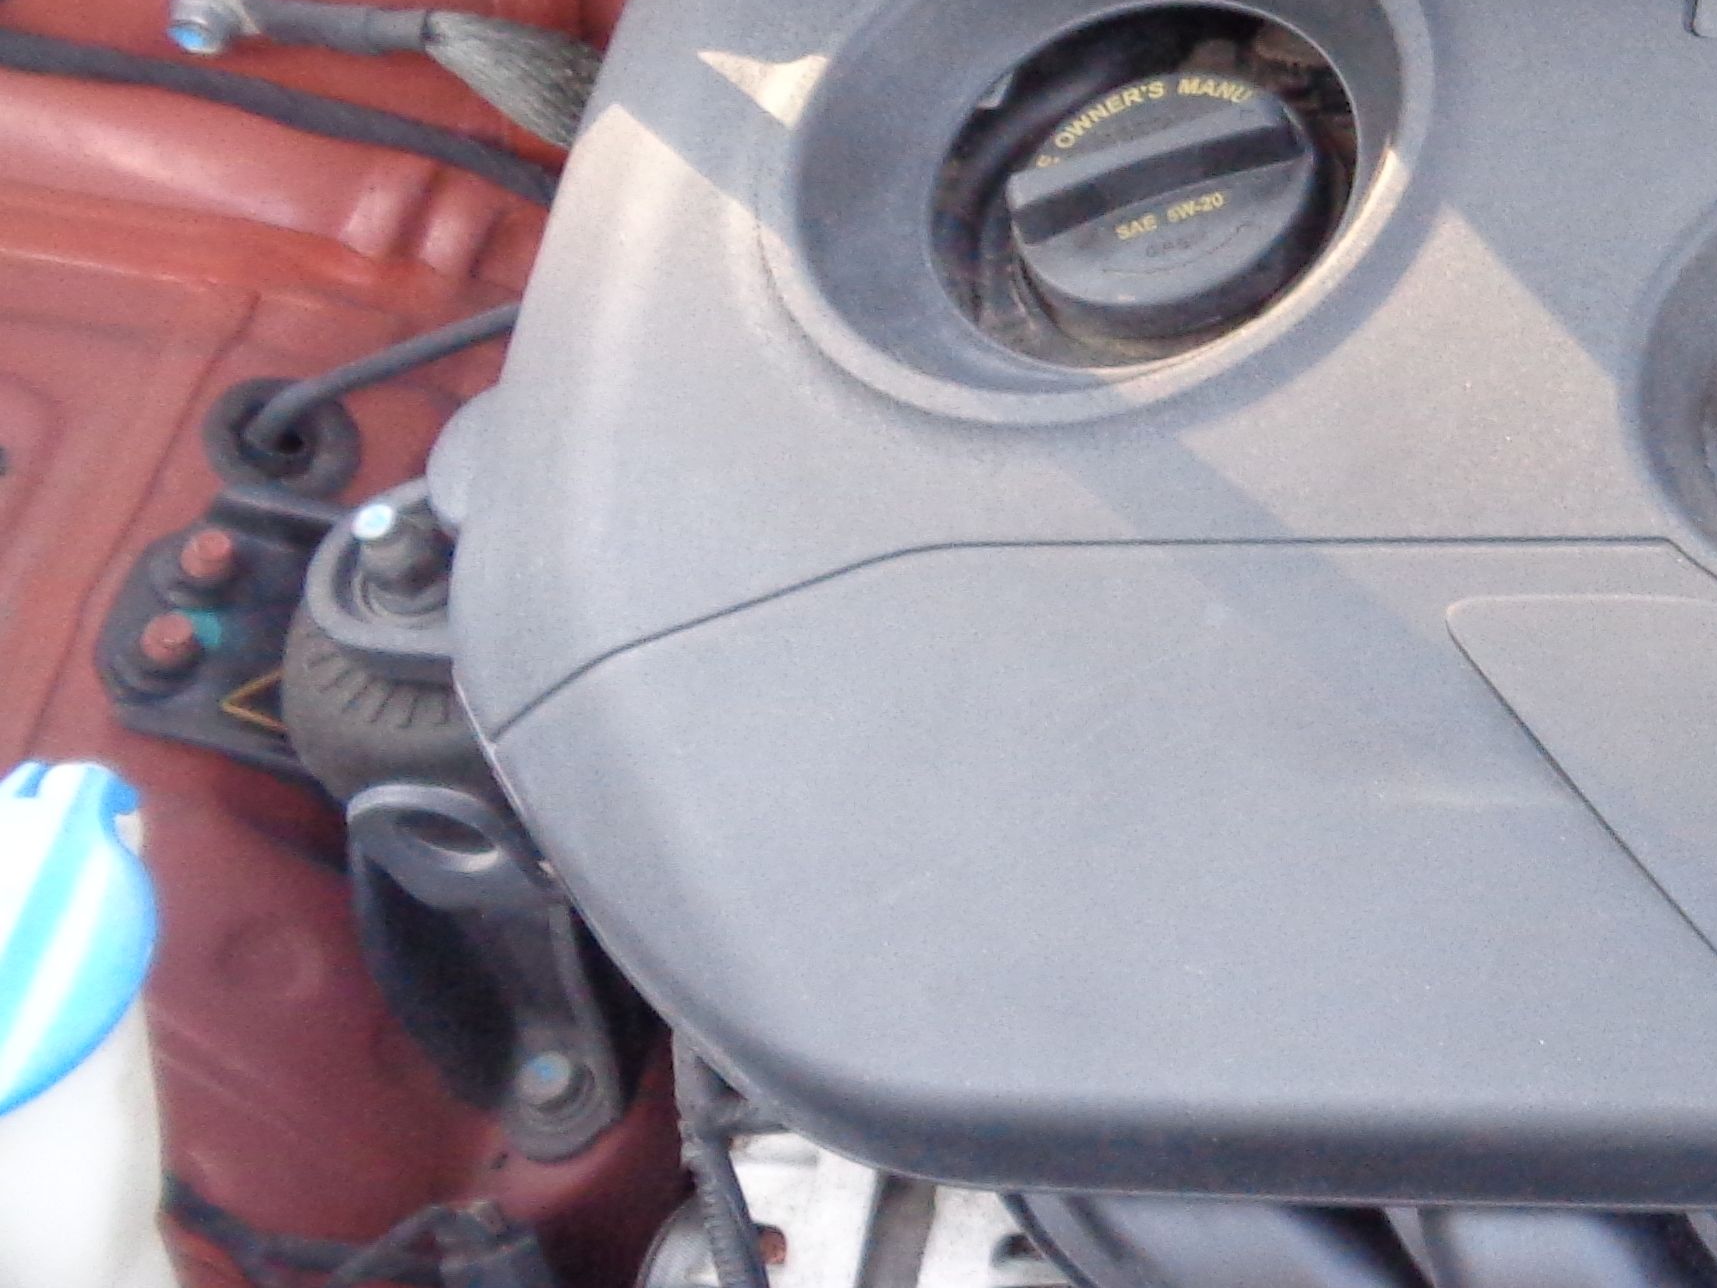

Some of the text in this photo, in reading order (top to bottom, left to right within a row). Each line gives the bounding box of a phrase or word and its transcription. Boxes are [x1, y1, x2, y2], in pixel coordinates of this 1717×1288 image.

[1054, 77, 1253, 149] OWNER'S MANU
[1115, 214, 1159, 241] SAE
